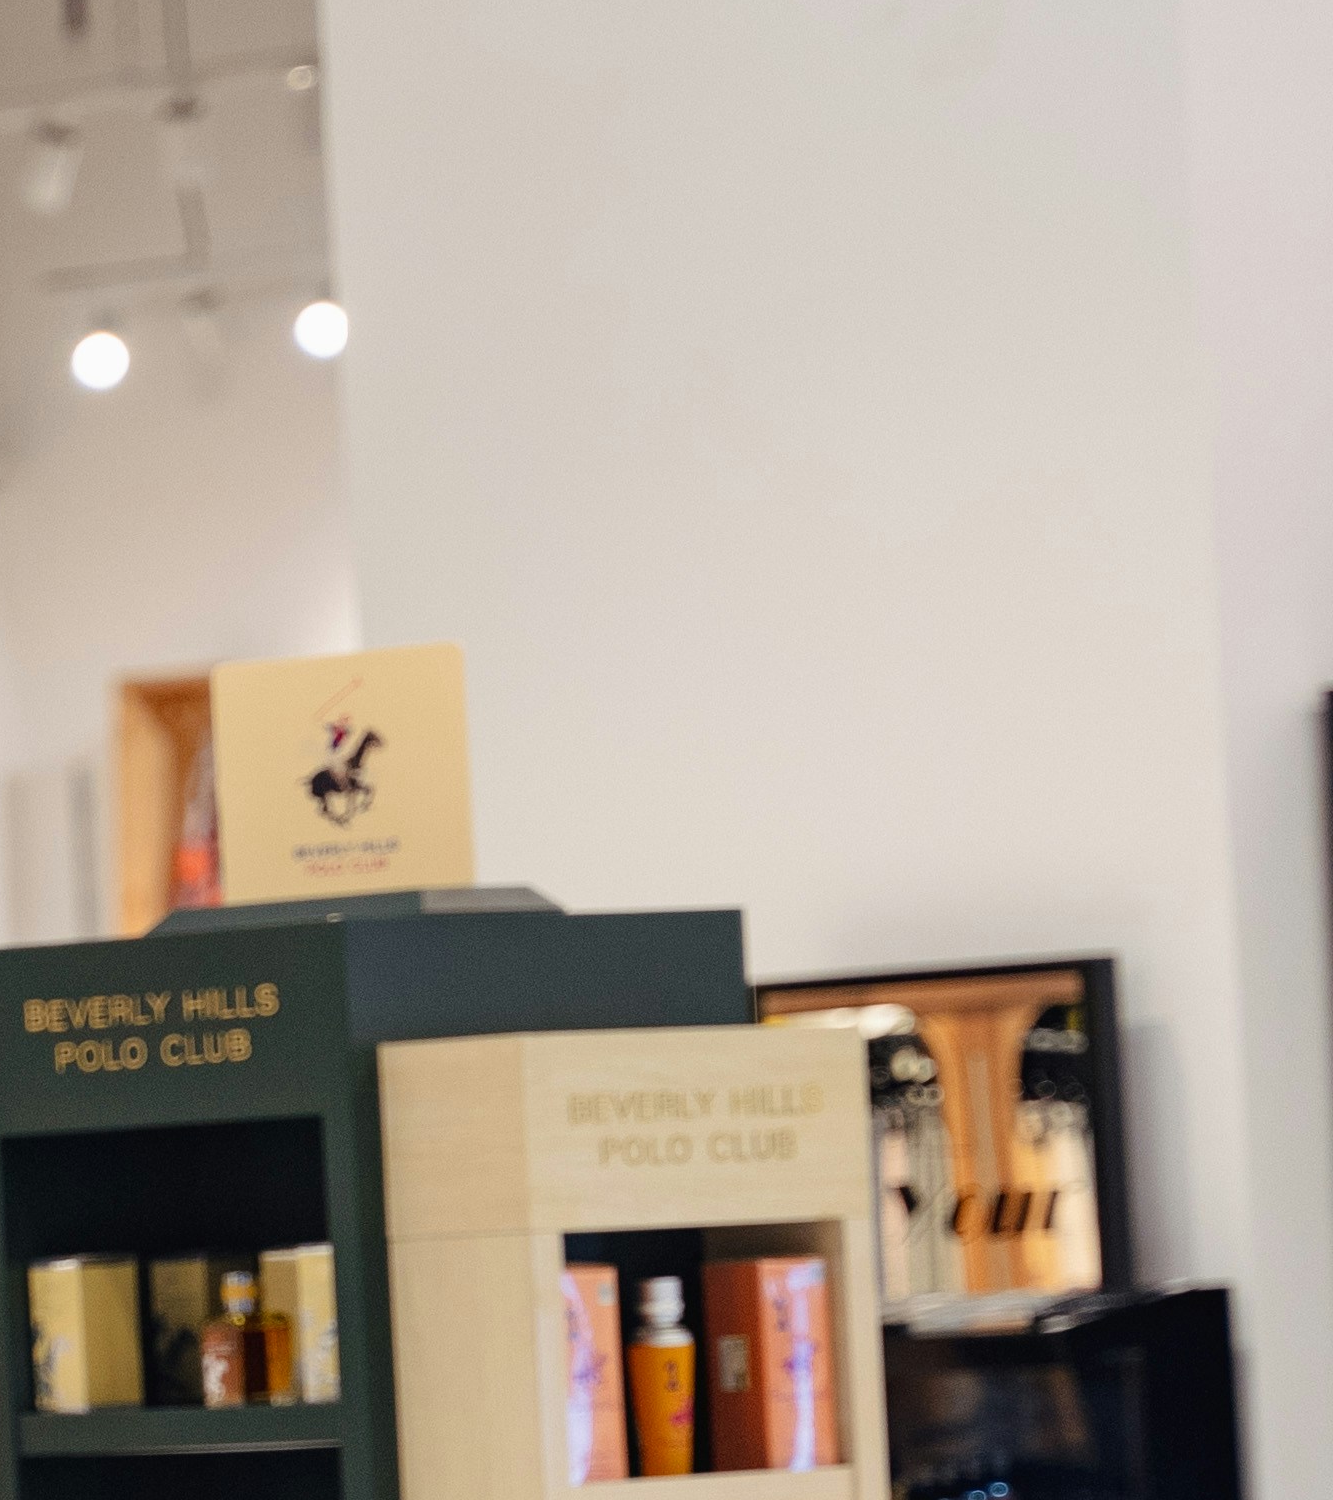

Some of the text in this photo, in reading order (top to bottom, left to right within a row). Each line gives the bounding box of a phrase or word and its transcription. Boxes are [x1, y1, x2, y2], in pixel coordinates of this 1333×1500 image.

[22, 982, 280, 1033] BEVERLY HILLS
[53, 1028, 252, 1075] POLO CLUB
[565, 1082, 825, 1126] BEVERLY HILLS
[597, 1125, 799, 1168] POLO CLUB
